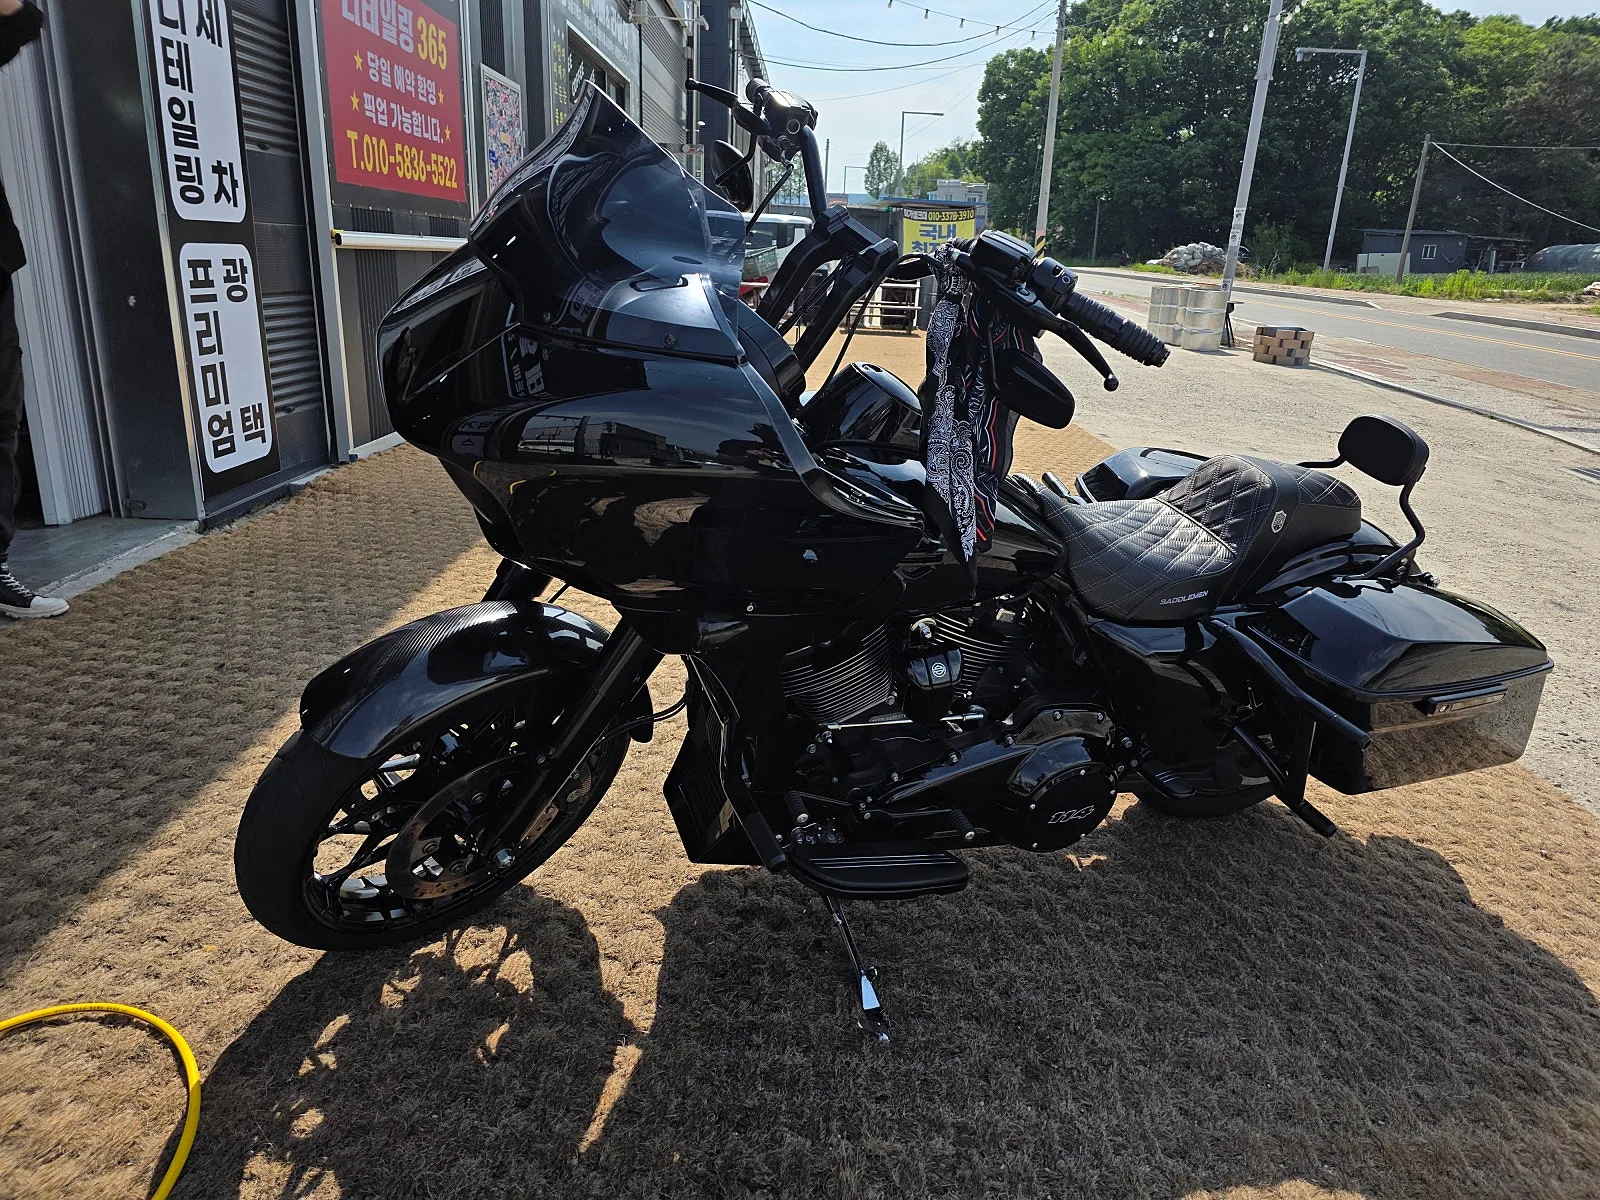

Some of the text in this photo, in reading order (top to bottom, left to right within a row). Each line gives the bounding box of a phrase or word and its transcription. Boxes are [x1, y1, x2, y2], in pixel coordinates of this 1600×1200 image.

[341, 0, 448, 71] 디테일링 365
[158, 0, 205, 205] 디테일링
[366, 50, 437, 106] 당일 예약 환영
[363, 91, 444, 144] 픽업 가능합니다.
[919, 223, 957, 241] 국내
[187, 258, 237, 460] 프리미엄
[221, 258, 267, 444] 광택
[1159, 590, 1209, 606] SADDLEMEN
[1047, 804, 1096, 824] 114
